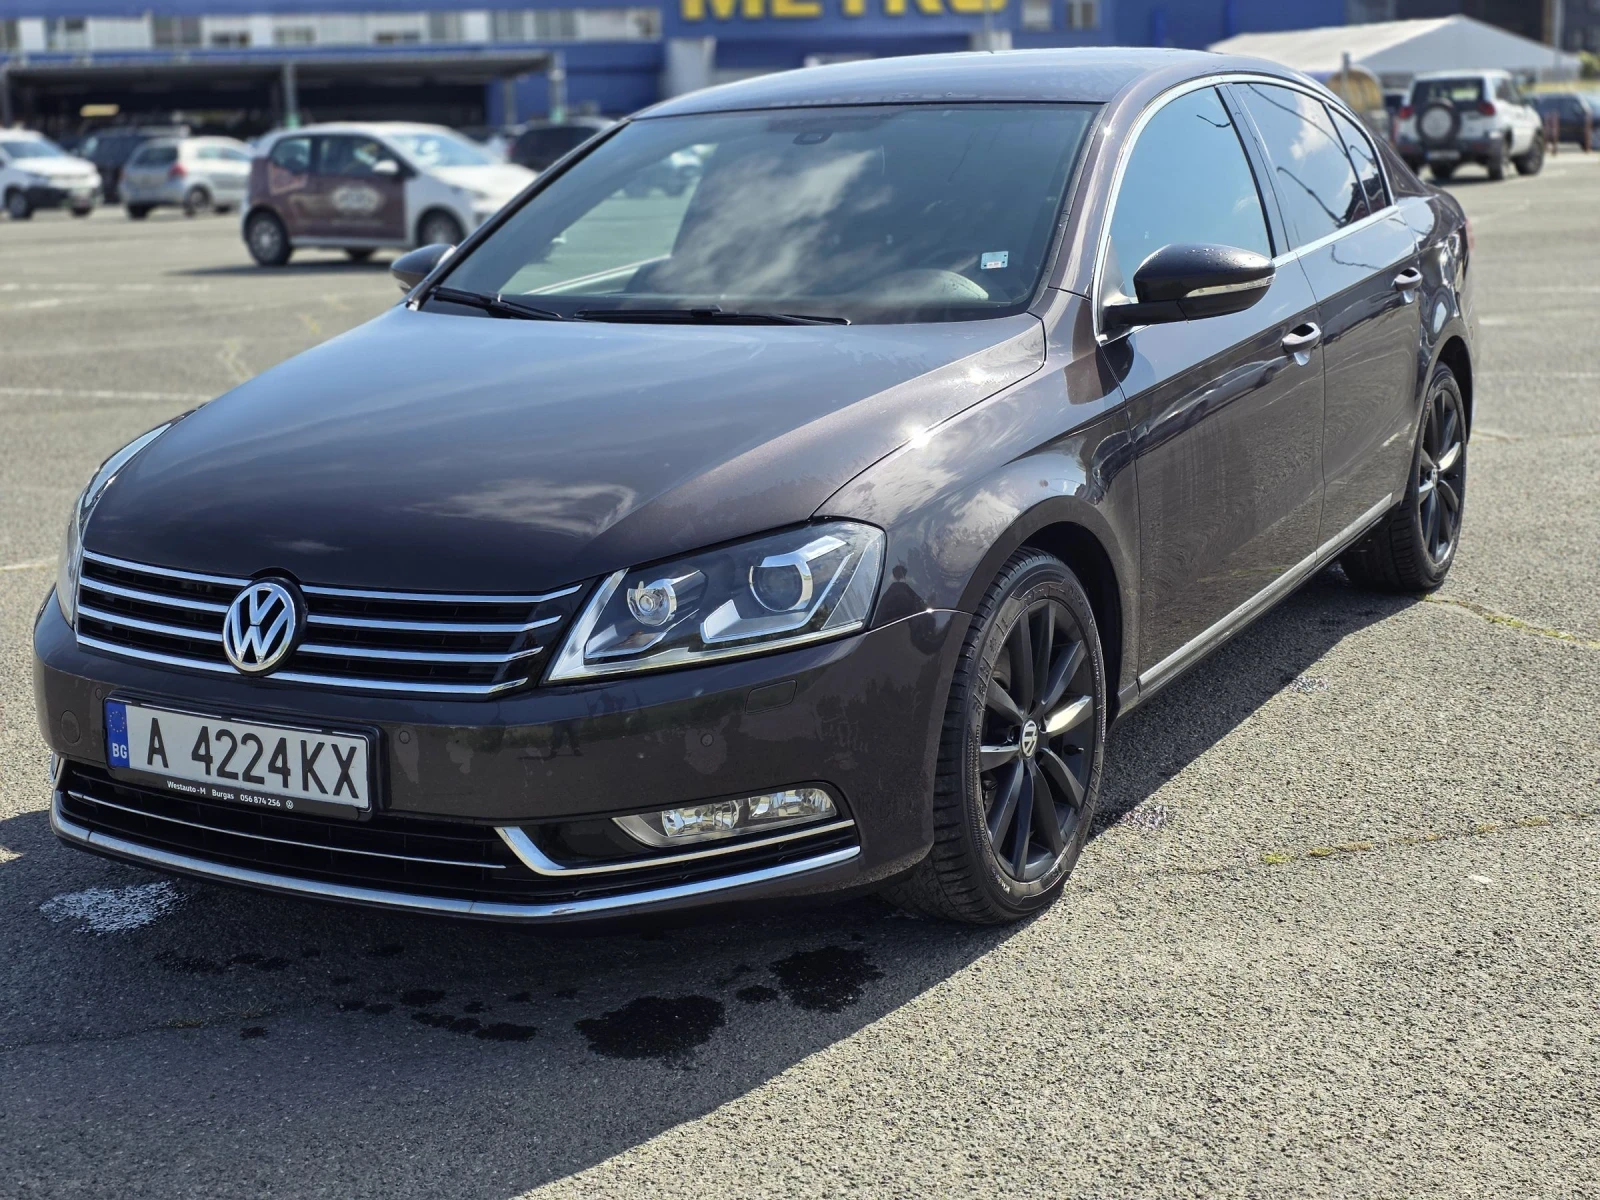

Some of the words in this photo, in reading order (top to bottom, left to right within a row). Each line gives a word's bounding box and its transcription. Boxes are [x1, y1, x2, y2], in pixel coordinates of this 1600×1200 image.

[112, 742, 128, 759] BG
[147, 717, 169, 769] A
[211, 788, 235, 800] Burgas
[240, 794, 253, 803] 056
[253, 796, 267, 805] 874
[267, 798, 281, 807] 256
